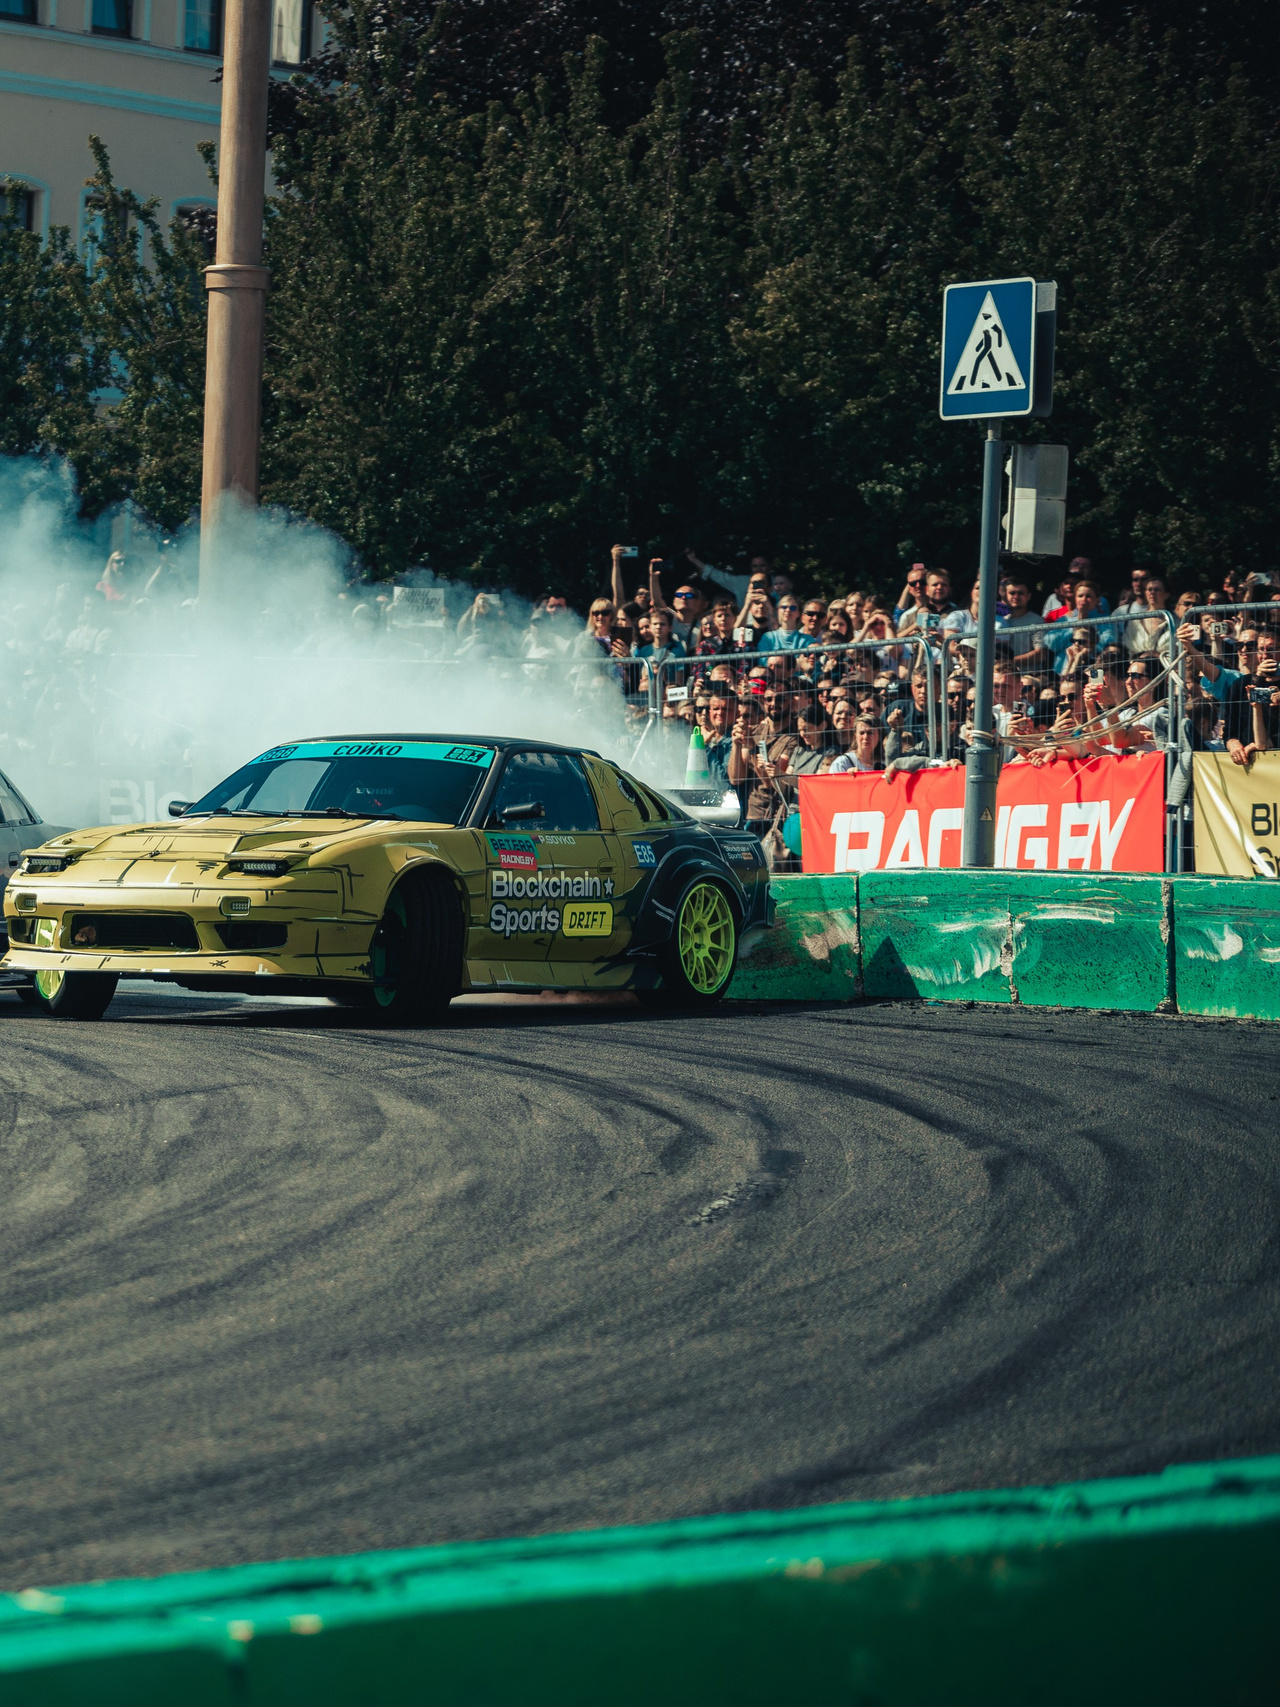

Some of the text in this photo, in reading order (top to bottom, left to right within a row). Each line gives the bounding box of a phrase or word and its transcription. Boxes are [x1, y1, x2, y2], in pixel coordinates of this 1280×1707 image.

[332, 742, 403, 756] СОЙКО
[1251, 802, 1280, 836] Bl
[633, 844, 656, 864] E85
[492, 870, 601, 898] Blockchain
[490, 903, 607, 937] Sports DRIFT
